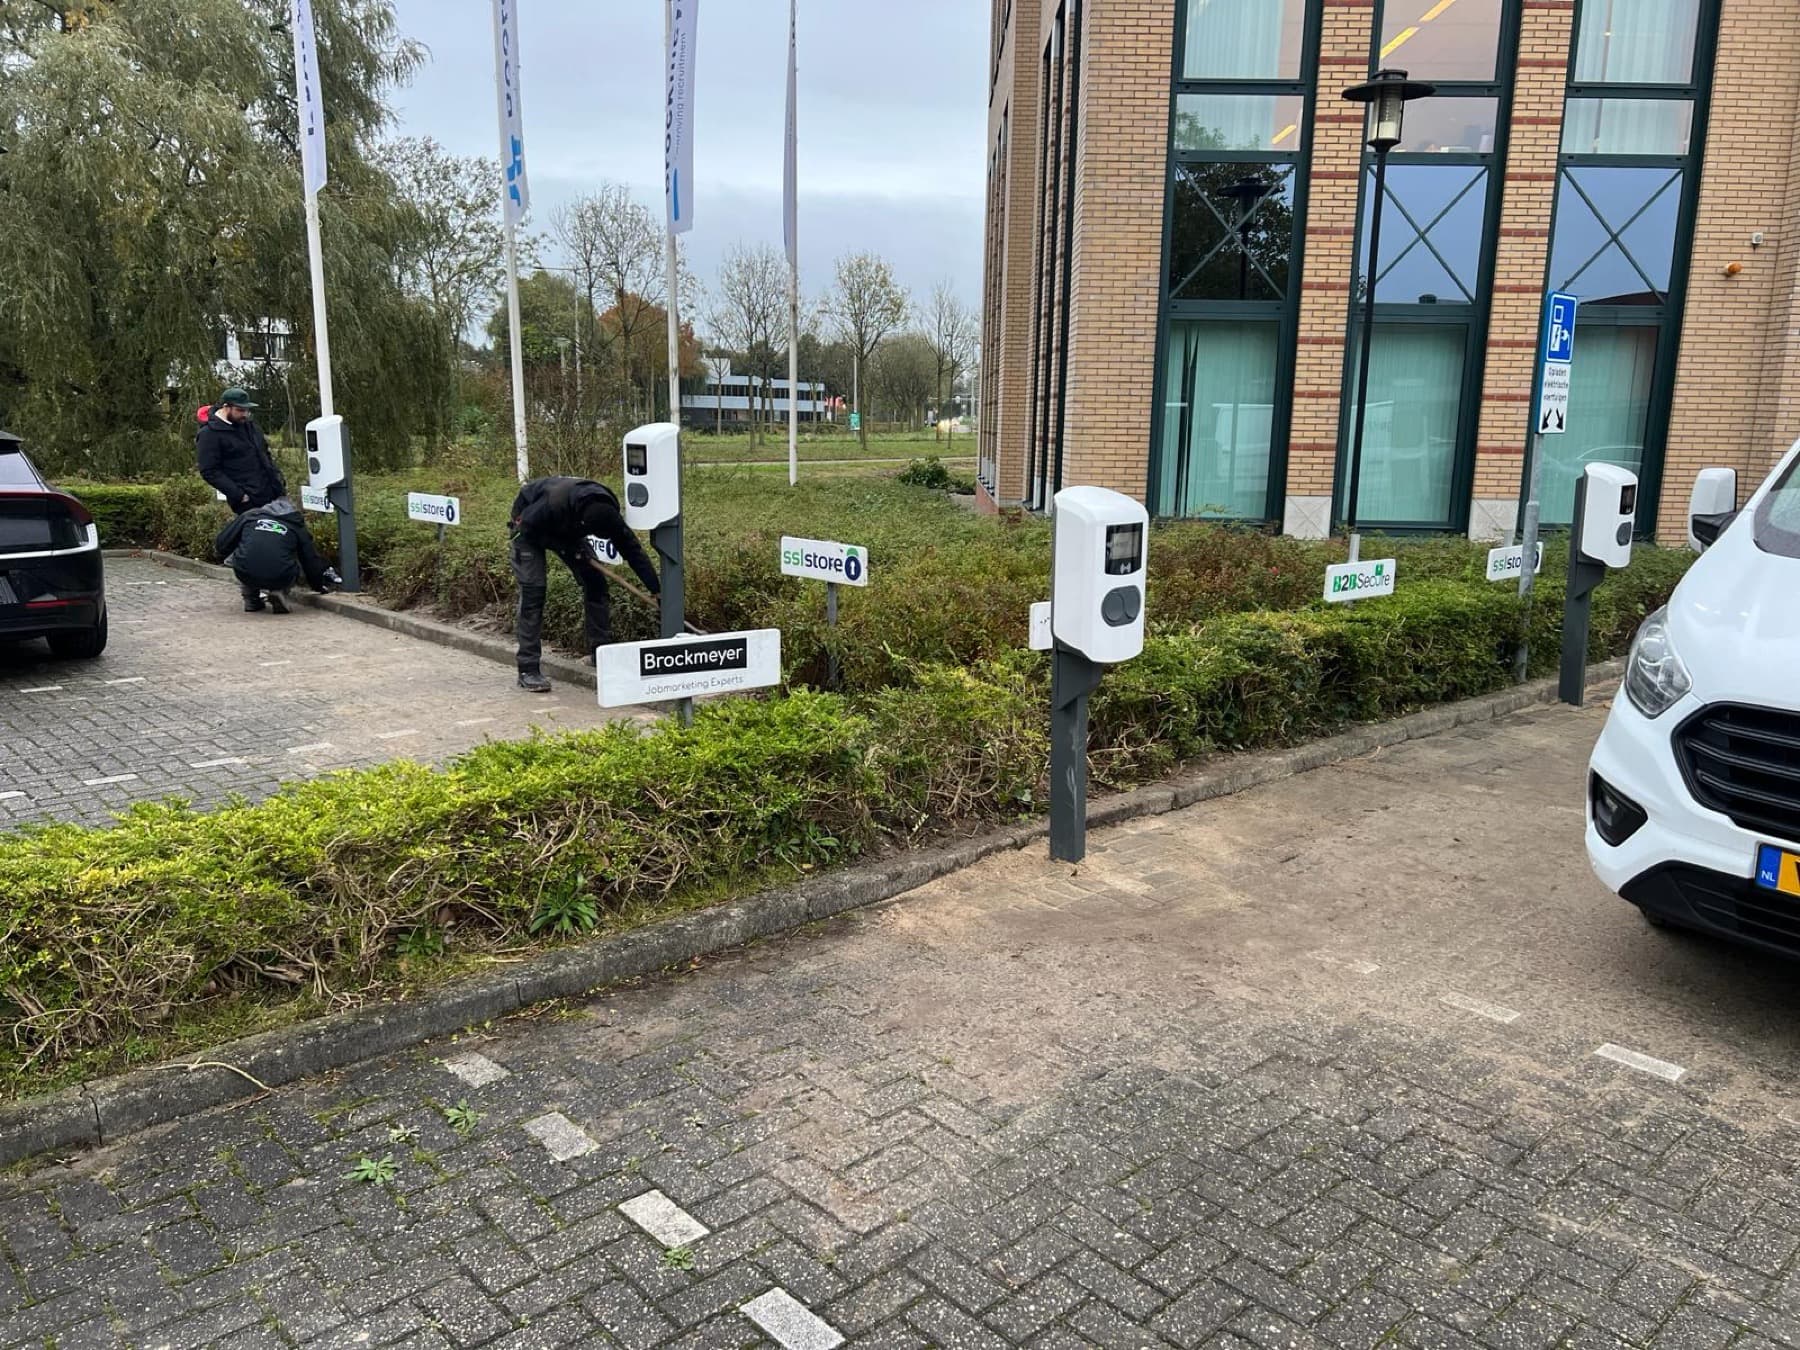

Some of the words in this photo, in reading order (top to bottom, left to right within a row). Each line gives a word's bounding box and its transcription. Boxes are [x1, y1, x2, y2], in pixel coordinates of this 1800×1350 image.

[783, 548, 843, 572] sslstore
[644, 647, 744, 670] Brockmeyer
[645, 678, 710, 695] Jobmarketing
[711, 675, 744, 689] Experts
[1761, 870, 1776, 882] NL
